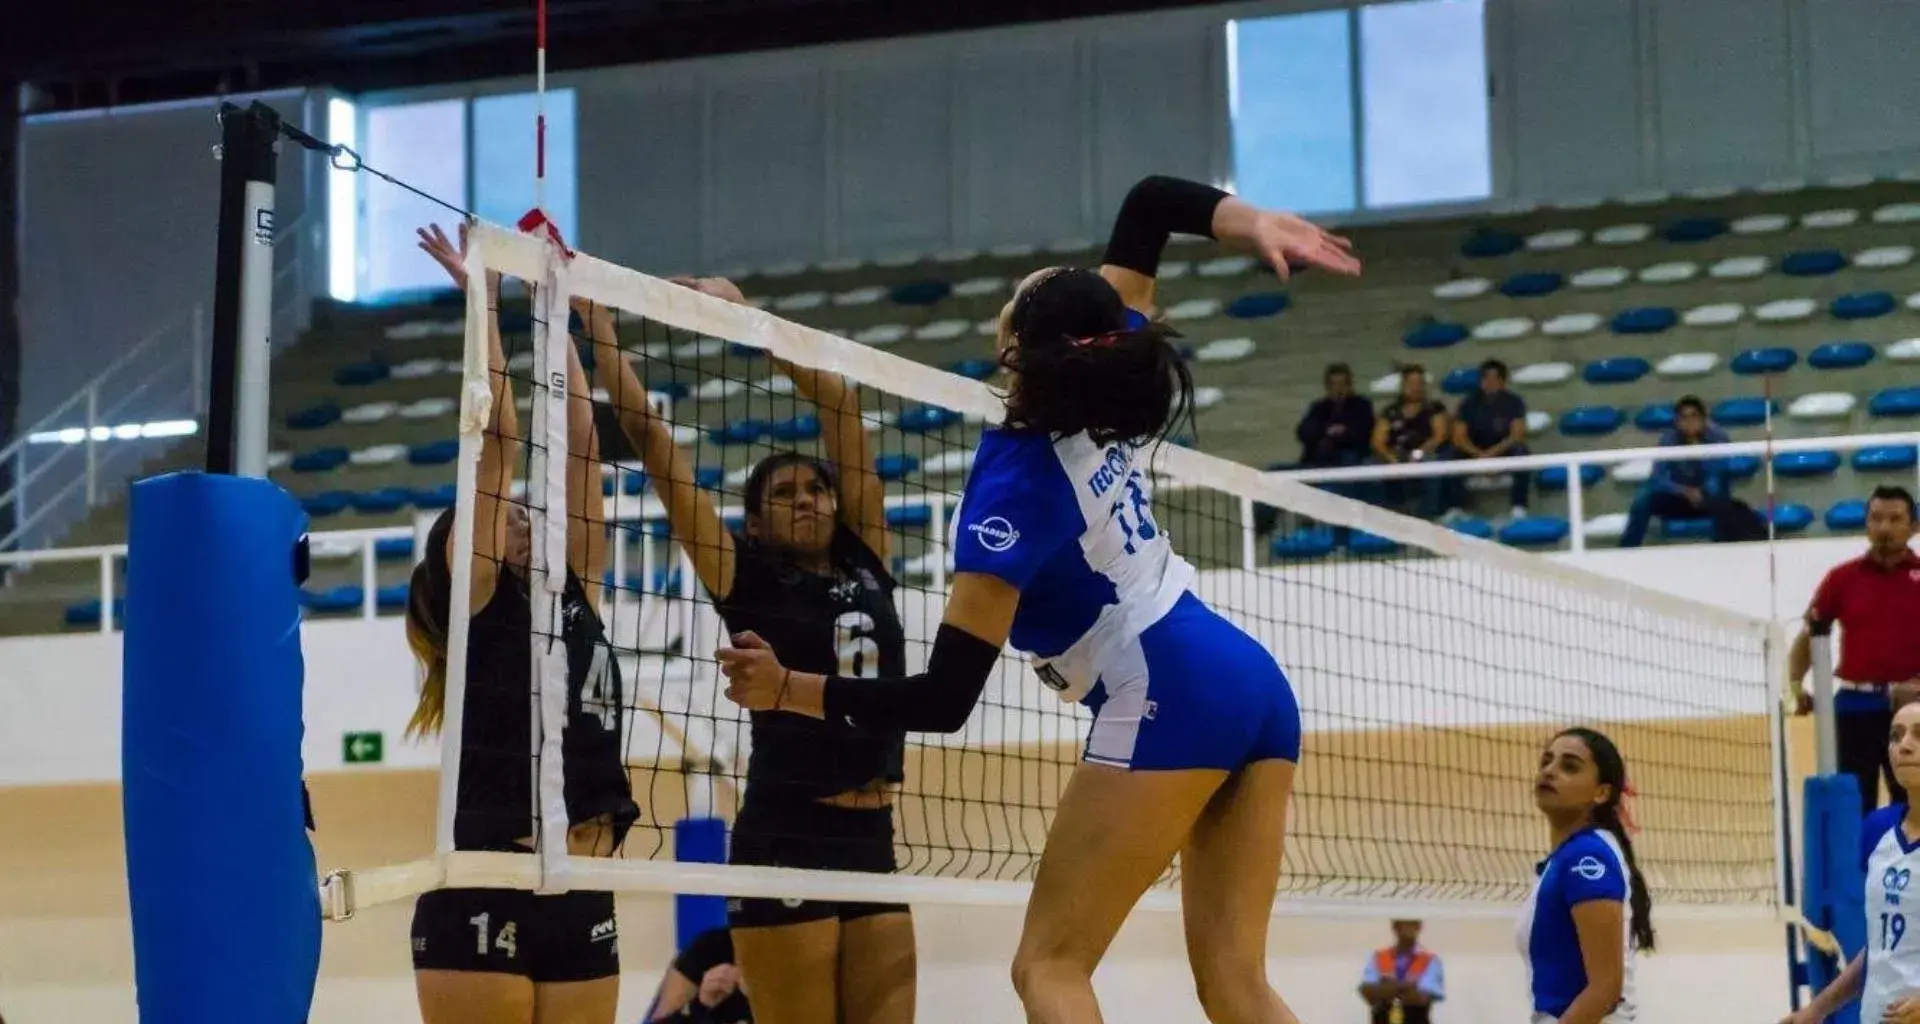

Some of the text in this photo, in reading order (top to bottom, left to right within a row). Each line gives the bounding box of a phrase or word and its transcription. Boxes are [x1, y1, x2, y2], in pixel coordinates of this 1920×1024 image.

[833, 611, 879, 679] 6
[469, 911, 517, 958] 14
[1880, 912, 1906, 951] 19
